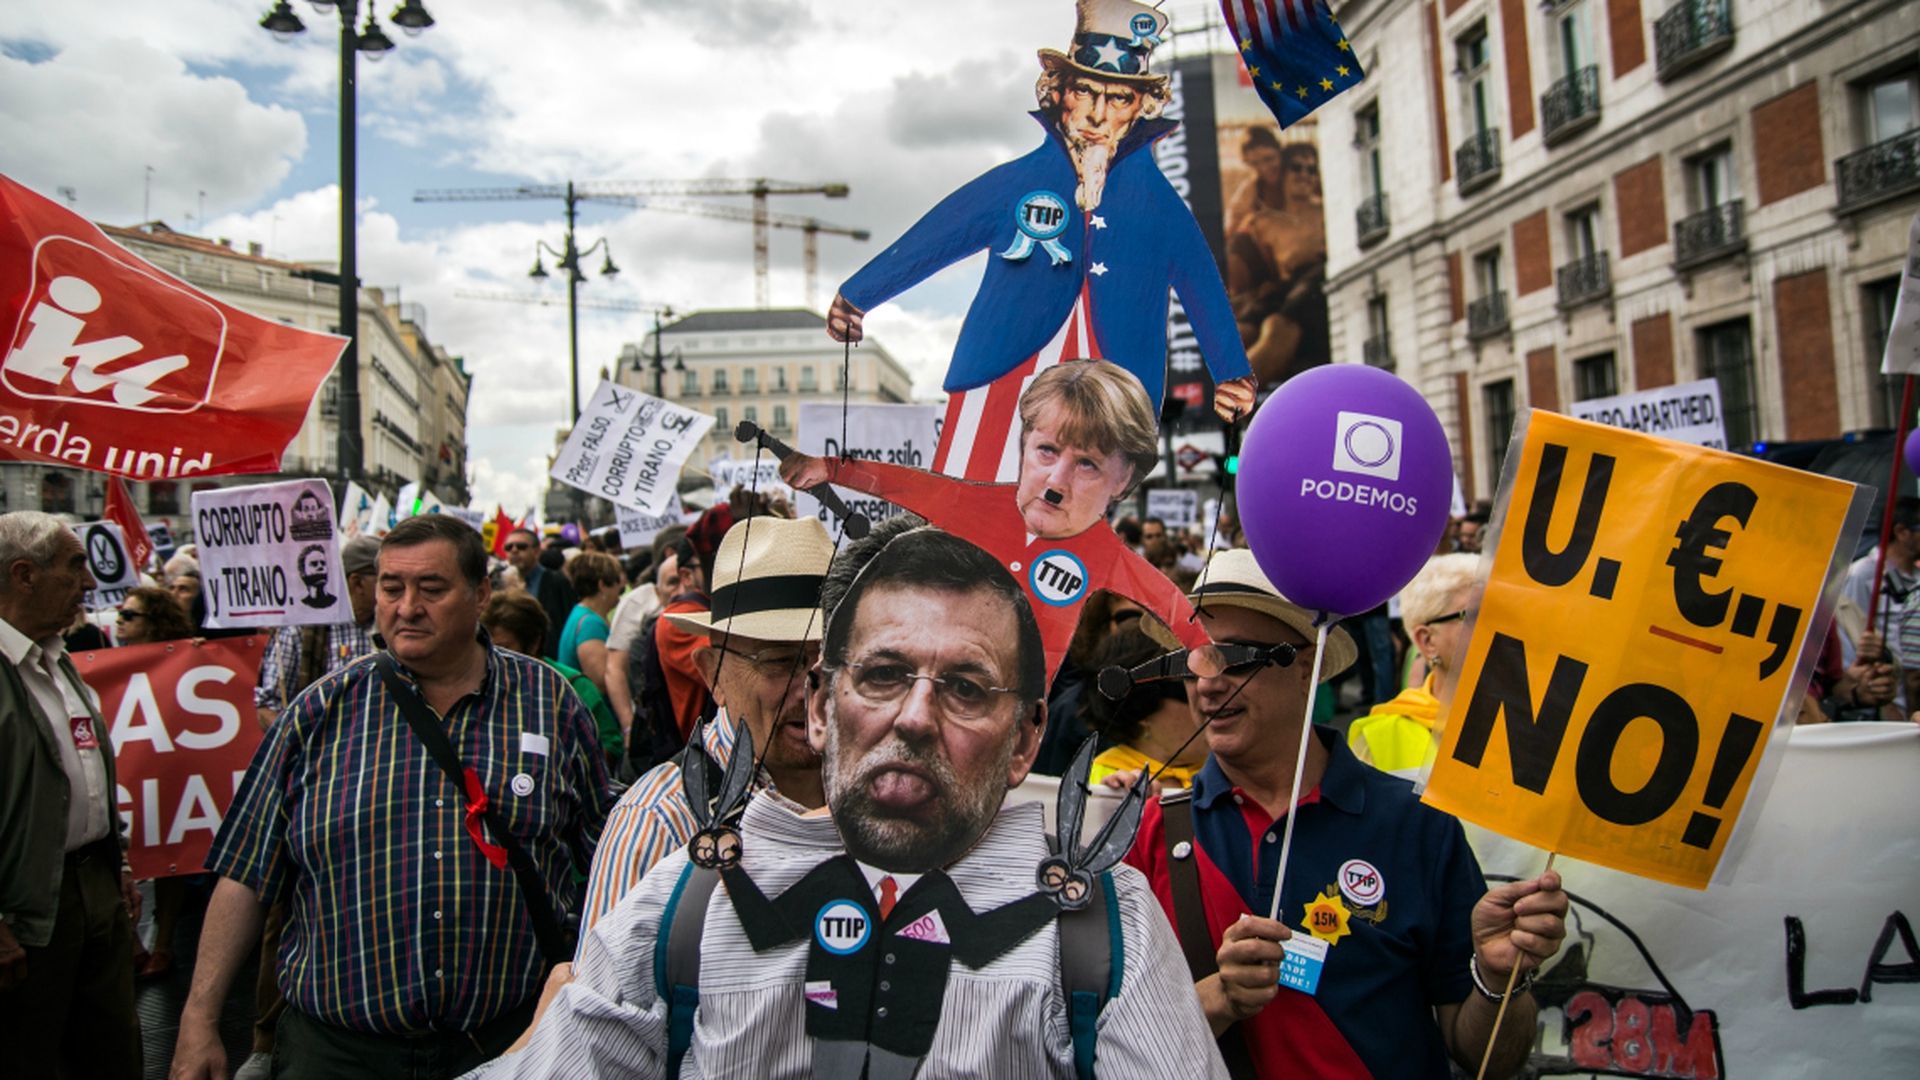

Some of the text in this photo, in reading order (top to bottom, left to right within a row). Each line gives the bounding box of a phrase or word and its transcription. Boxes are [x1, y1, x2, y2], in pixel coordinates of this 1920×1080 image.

[1024, 203, 1065, 227] TTIP
[1579, 394, 1720, 433] RO-APARTHEID,
[602, 425, 646, 497] CORRUPTO
[1300, 478, 1418, 516] PODEMOS
[199, 502, 286, 548] CORRUPTO
[1522, 443, 1621, 600] U.
[208, 565, 294, 618] y TIRANO.
[1037, 560, 1083, 595] TTIP
[88, 665, 241, 757] AS
[1452, 631, 1764, 850] NO!
[823, 917, 865, 938] TTIP
[903, 916, 935, 939] 500
[1314, 911, 1338, 927] 15M
[1284, 952, 1307, 966] DAD
[1784, 909, 1920, 1010] LA
[1567, 991, 1718, 1079] 28M
